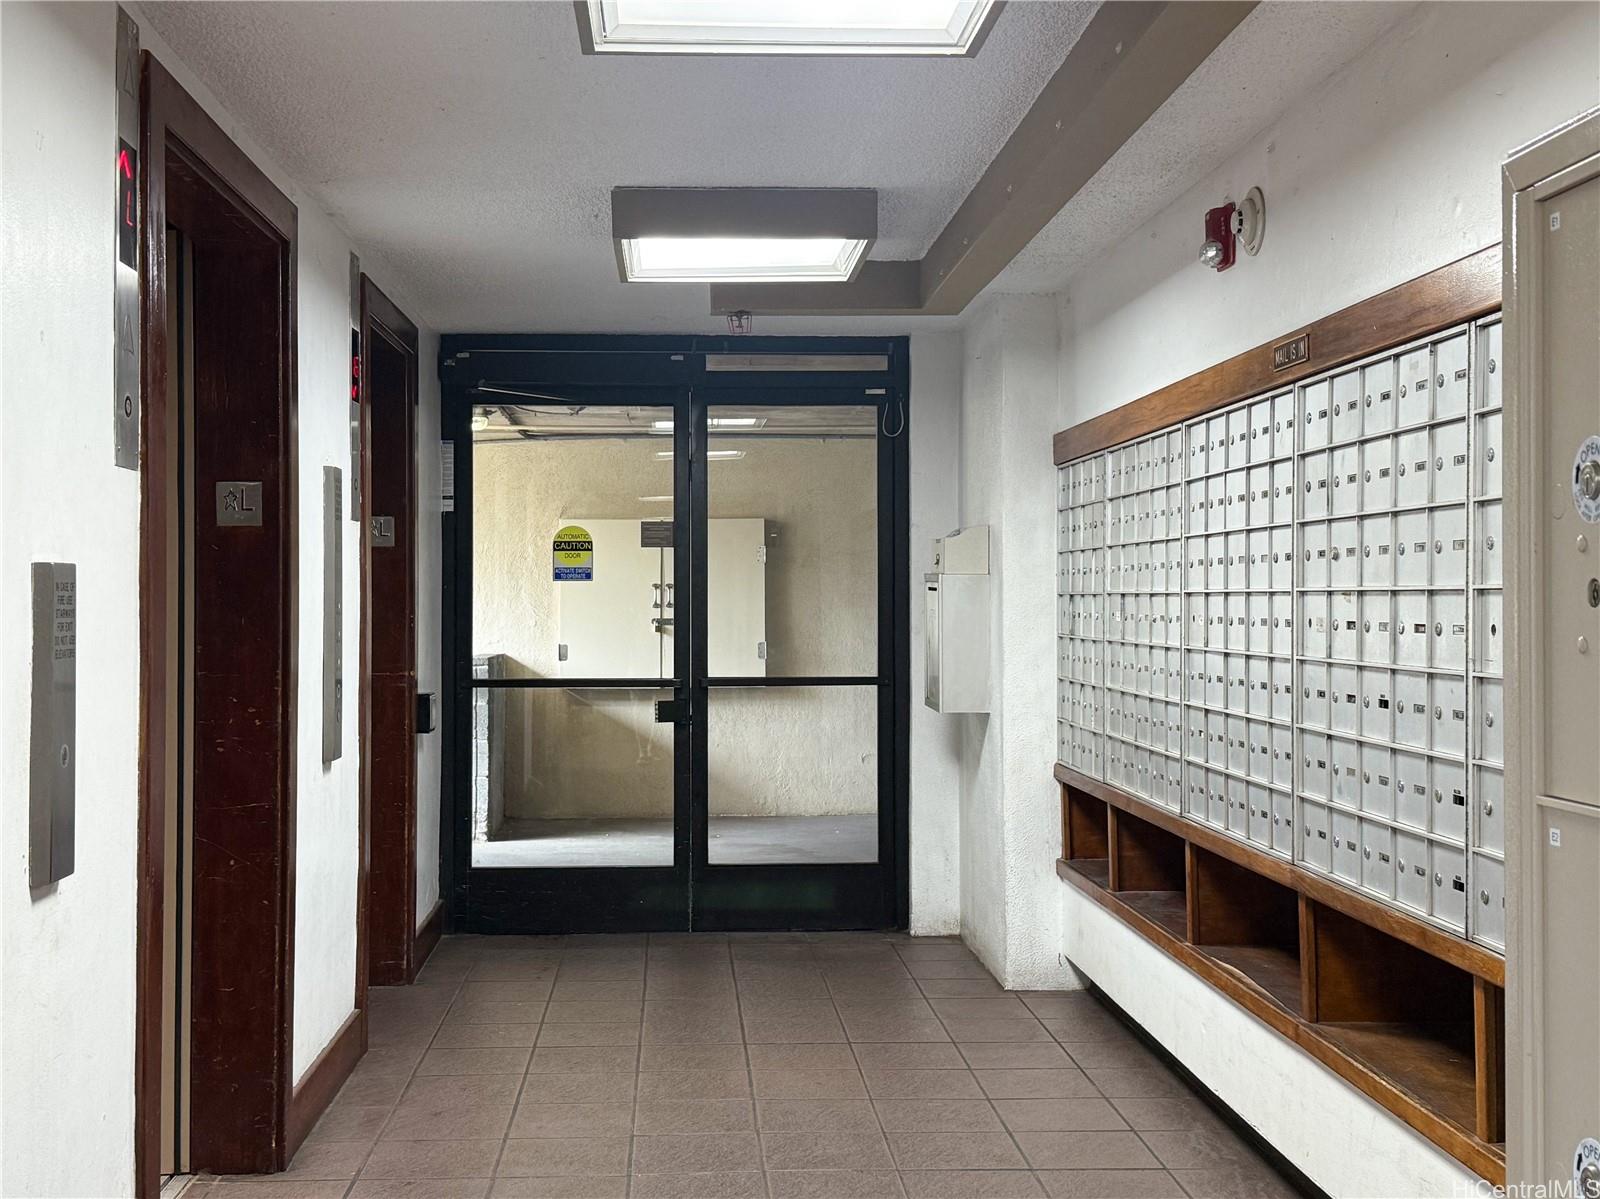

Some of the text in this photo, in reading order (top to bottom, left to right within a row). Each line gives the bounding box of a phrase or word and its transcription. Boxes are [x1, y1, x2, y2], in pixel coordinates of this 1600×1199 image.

[1275, 339, 1305, 367] MAIL IS IN
[1580, 441, 1600, 463] OPEN
[240, 486, 255, 511] L
[380, 519, 391, 537] L
[554, 542, 592, 550] CAUTION
[1583, 1144, 1600, 1161] OPE
